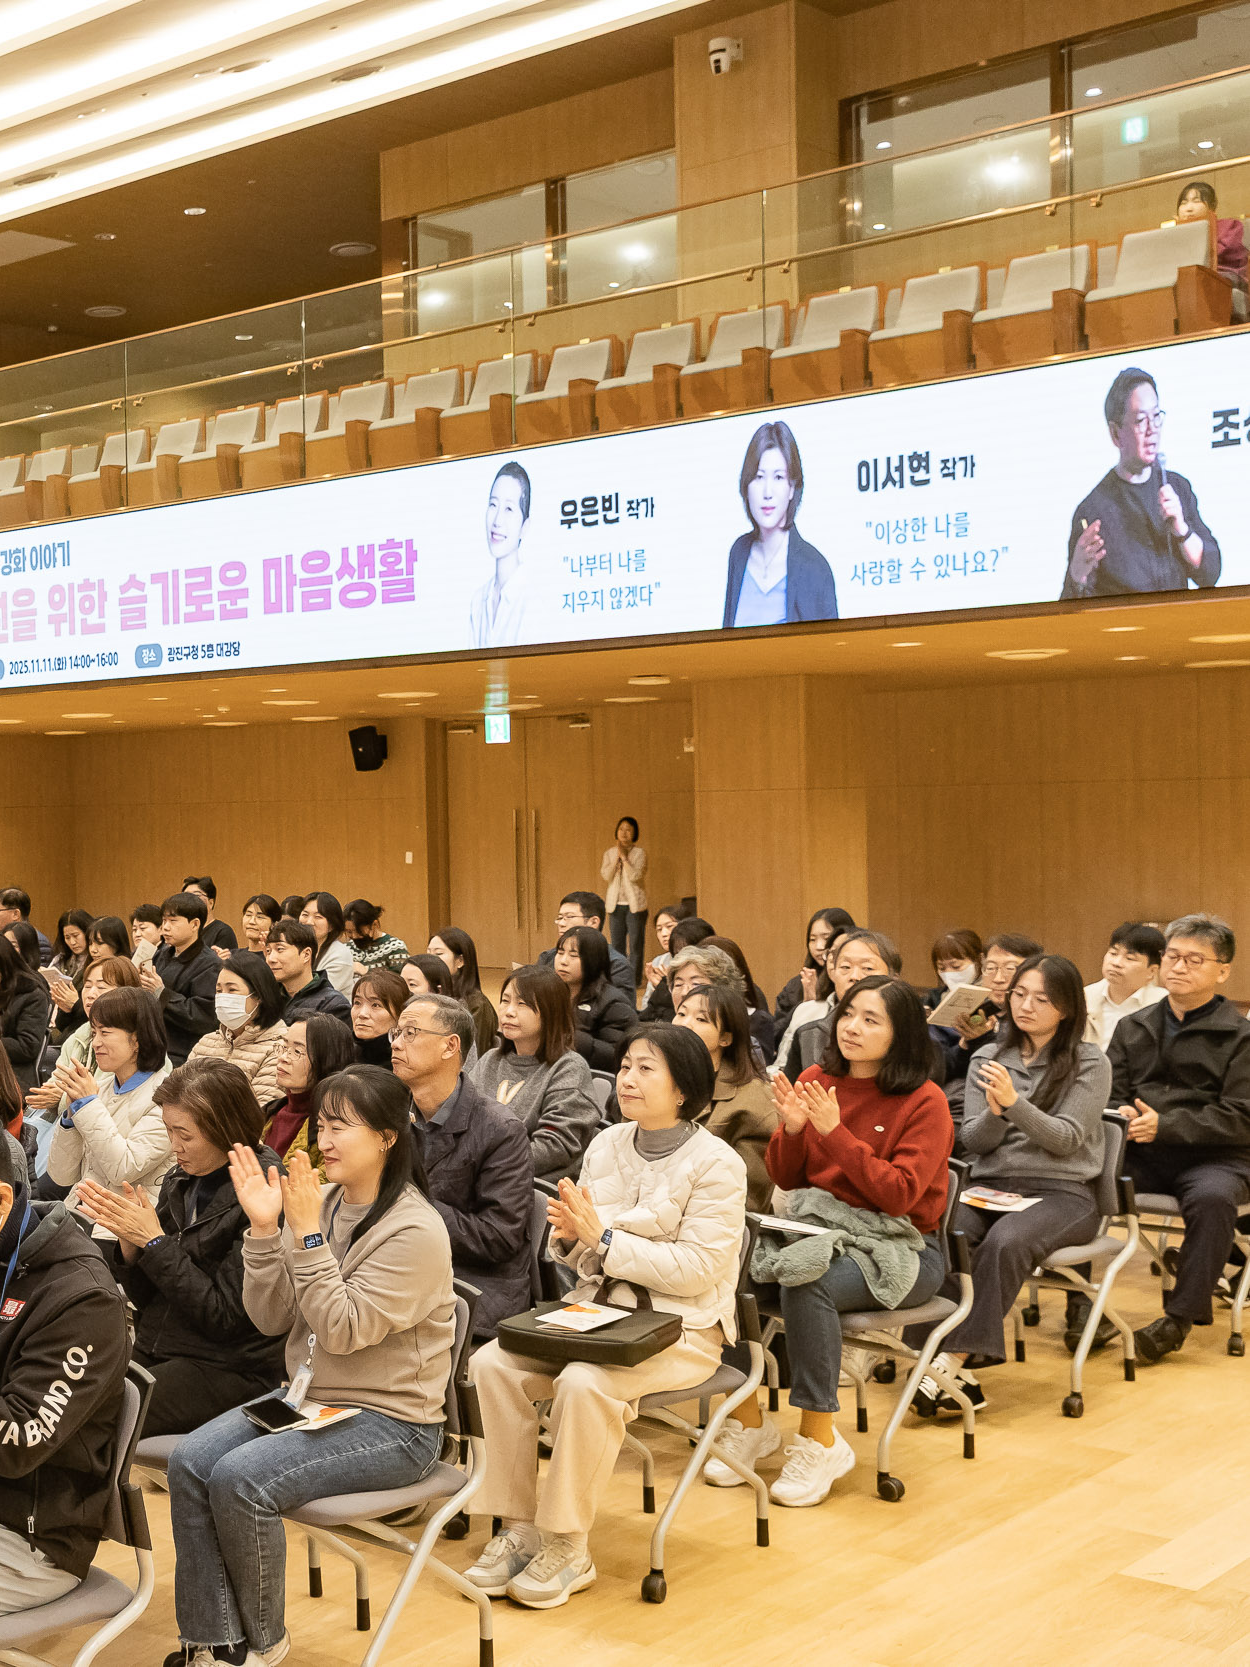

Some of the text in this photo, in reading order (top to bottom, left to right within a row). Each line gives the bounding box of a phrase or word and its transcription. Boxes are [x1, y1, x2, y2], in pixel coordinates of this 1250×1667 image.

[1211, 408, 1250, 449] 조
[857, 450, 976, 492] 이서현 작가
[560, 492, 655, 529] 우은빈 작가
[865, 511, 970, 545] "이상한 나를
[0, 546, 27, 576] 강화
[29, 540, 71, 571] 이야기
[562, 548, 647, 578] "나부터 나를
[850, 546, 1009, 586] 사랑할 수 있나요?"
[47, 577, 108, 637] 위한
[118, 560, 249, 632] 슬기로운
[261, 538, 418, 615] 마음생활
[562, 581, 661, 614] 지우지 않겠다"
[141, 647, 157, 664] 장소
[167, 641, 241, 662] 광진구청 5층 대강당
[23, 1379, 73, 1447] BRAND
[62, 1344, 94, 1381] CO.
